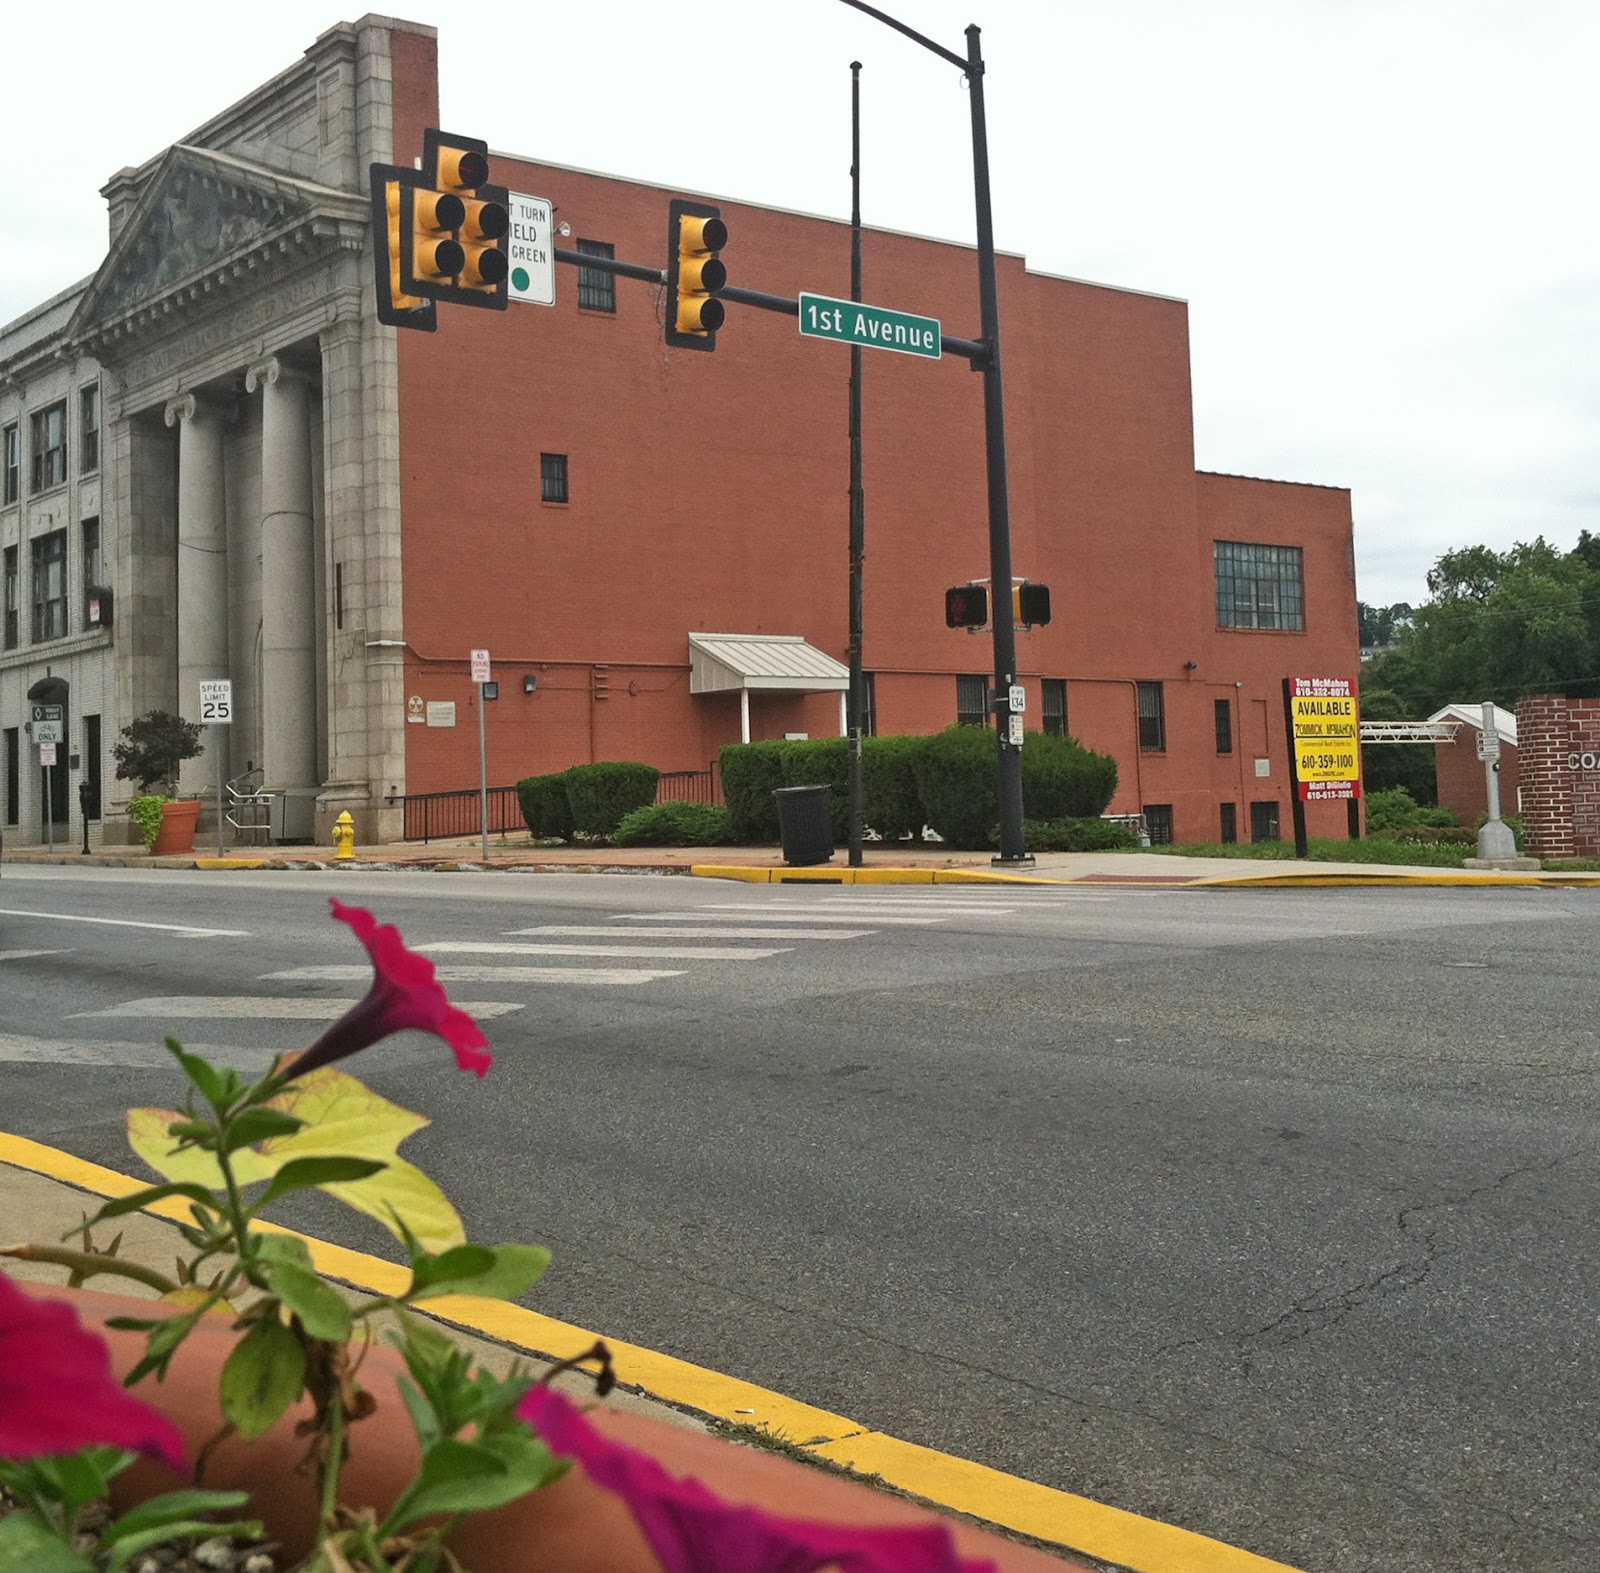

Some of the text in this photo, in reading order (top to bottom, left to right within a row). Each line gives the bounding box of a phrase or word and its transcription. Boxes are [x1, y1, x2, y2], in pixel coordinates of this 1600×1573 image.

[520, 205, 546, 223] TURN
[509, 222, 537, 242] IELD
[512, 245, 546, 264] GREEN
[808, 305, 934, 349] 1st Avenue
[202, 684, 229, 692] SPEED
[1295, 678, 1349, 688] Tom McMahon
[204, 703, 229, 718] 25
[1298, 702, 1351, 715] AVAILABLE
[38, 733, 57, 741] ONLY
[1302, 754, 1354, 769] 610-359-1100
[1568, 753, 1600, 770] CO
[1309, 782, 1325, 790] Matt
